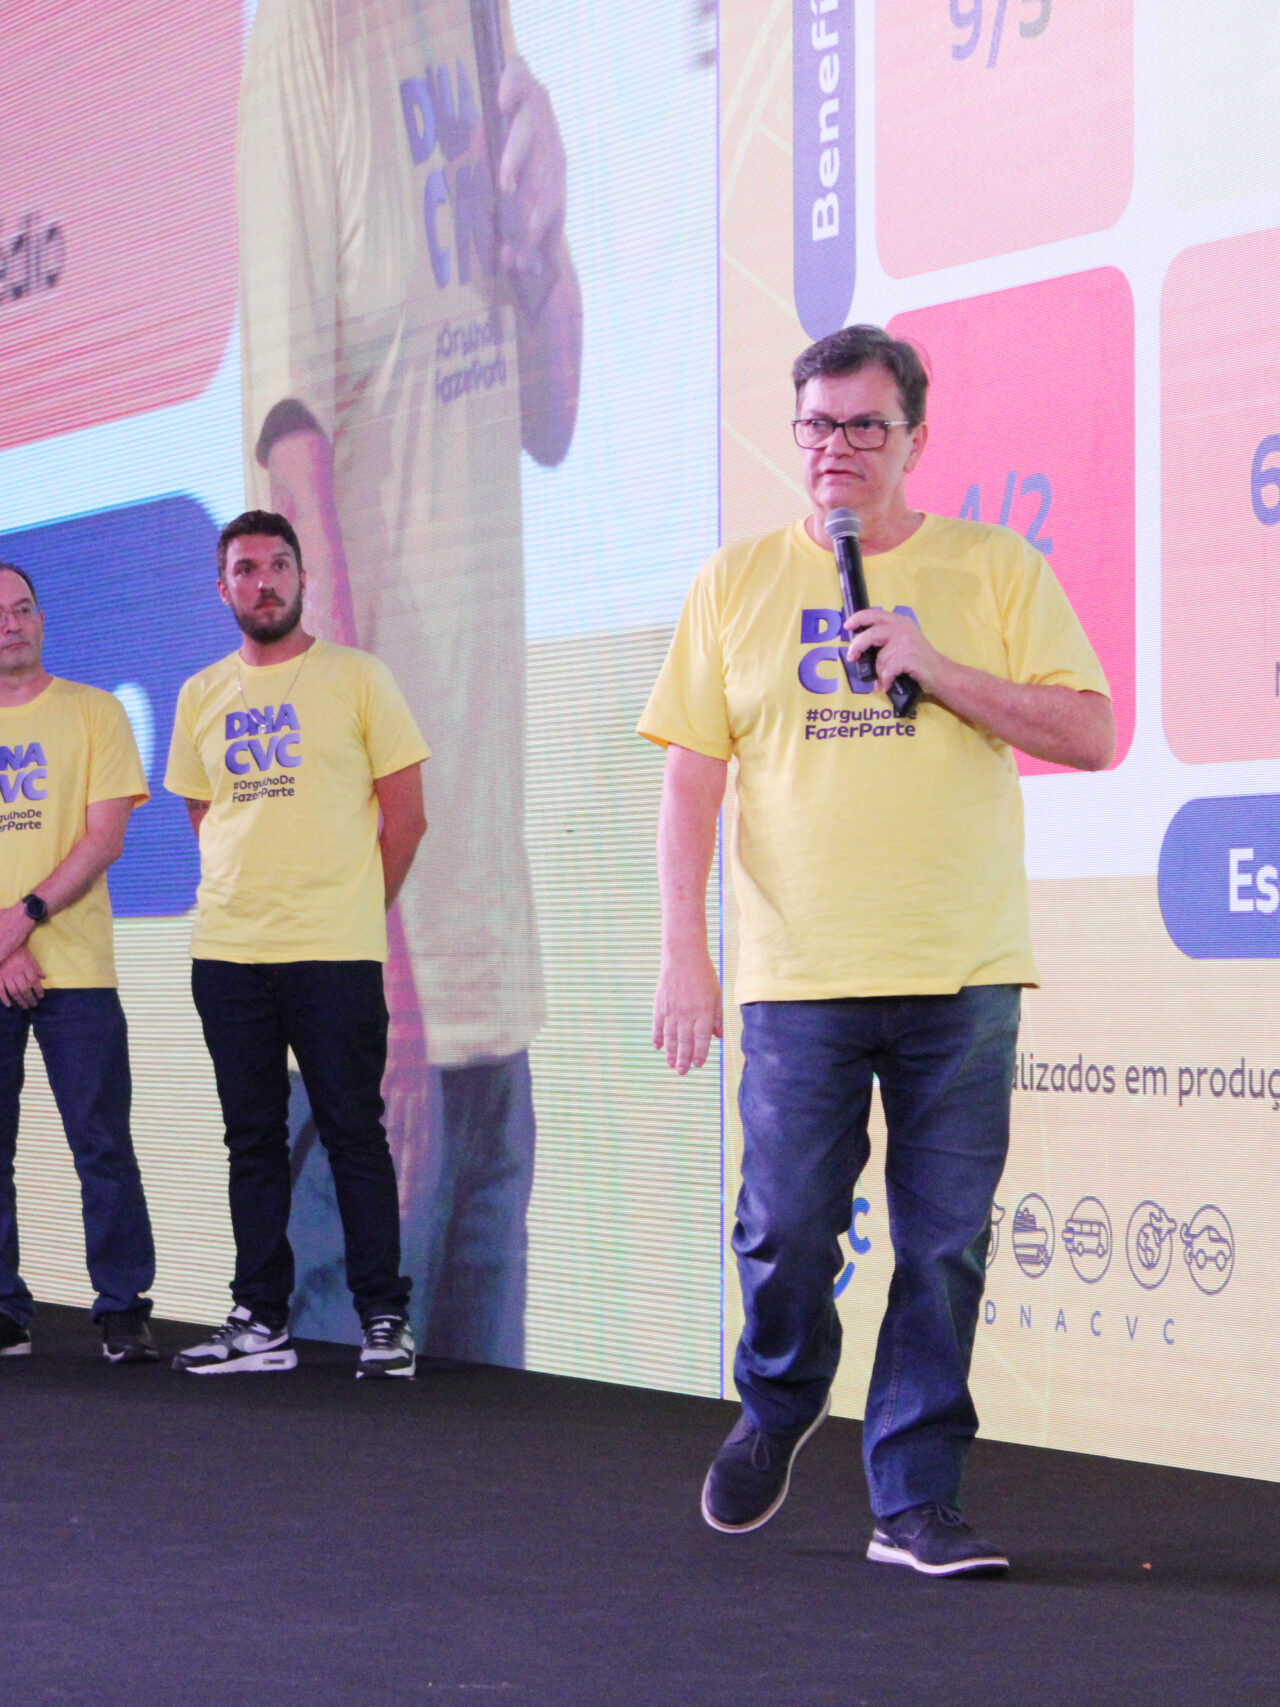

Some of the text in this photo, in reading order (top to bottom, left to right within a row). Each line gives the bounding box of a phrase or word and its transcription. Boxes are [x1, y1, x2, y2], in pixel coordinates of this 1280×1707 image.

[798, 645, 876, 695] CV
[225, 703, 301, 740] DNA
[805, 722, 916, 740] FazerParte
[225, 732, 302, 775] CVC
[1124, 1064, 1168, 1097] em
